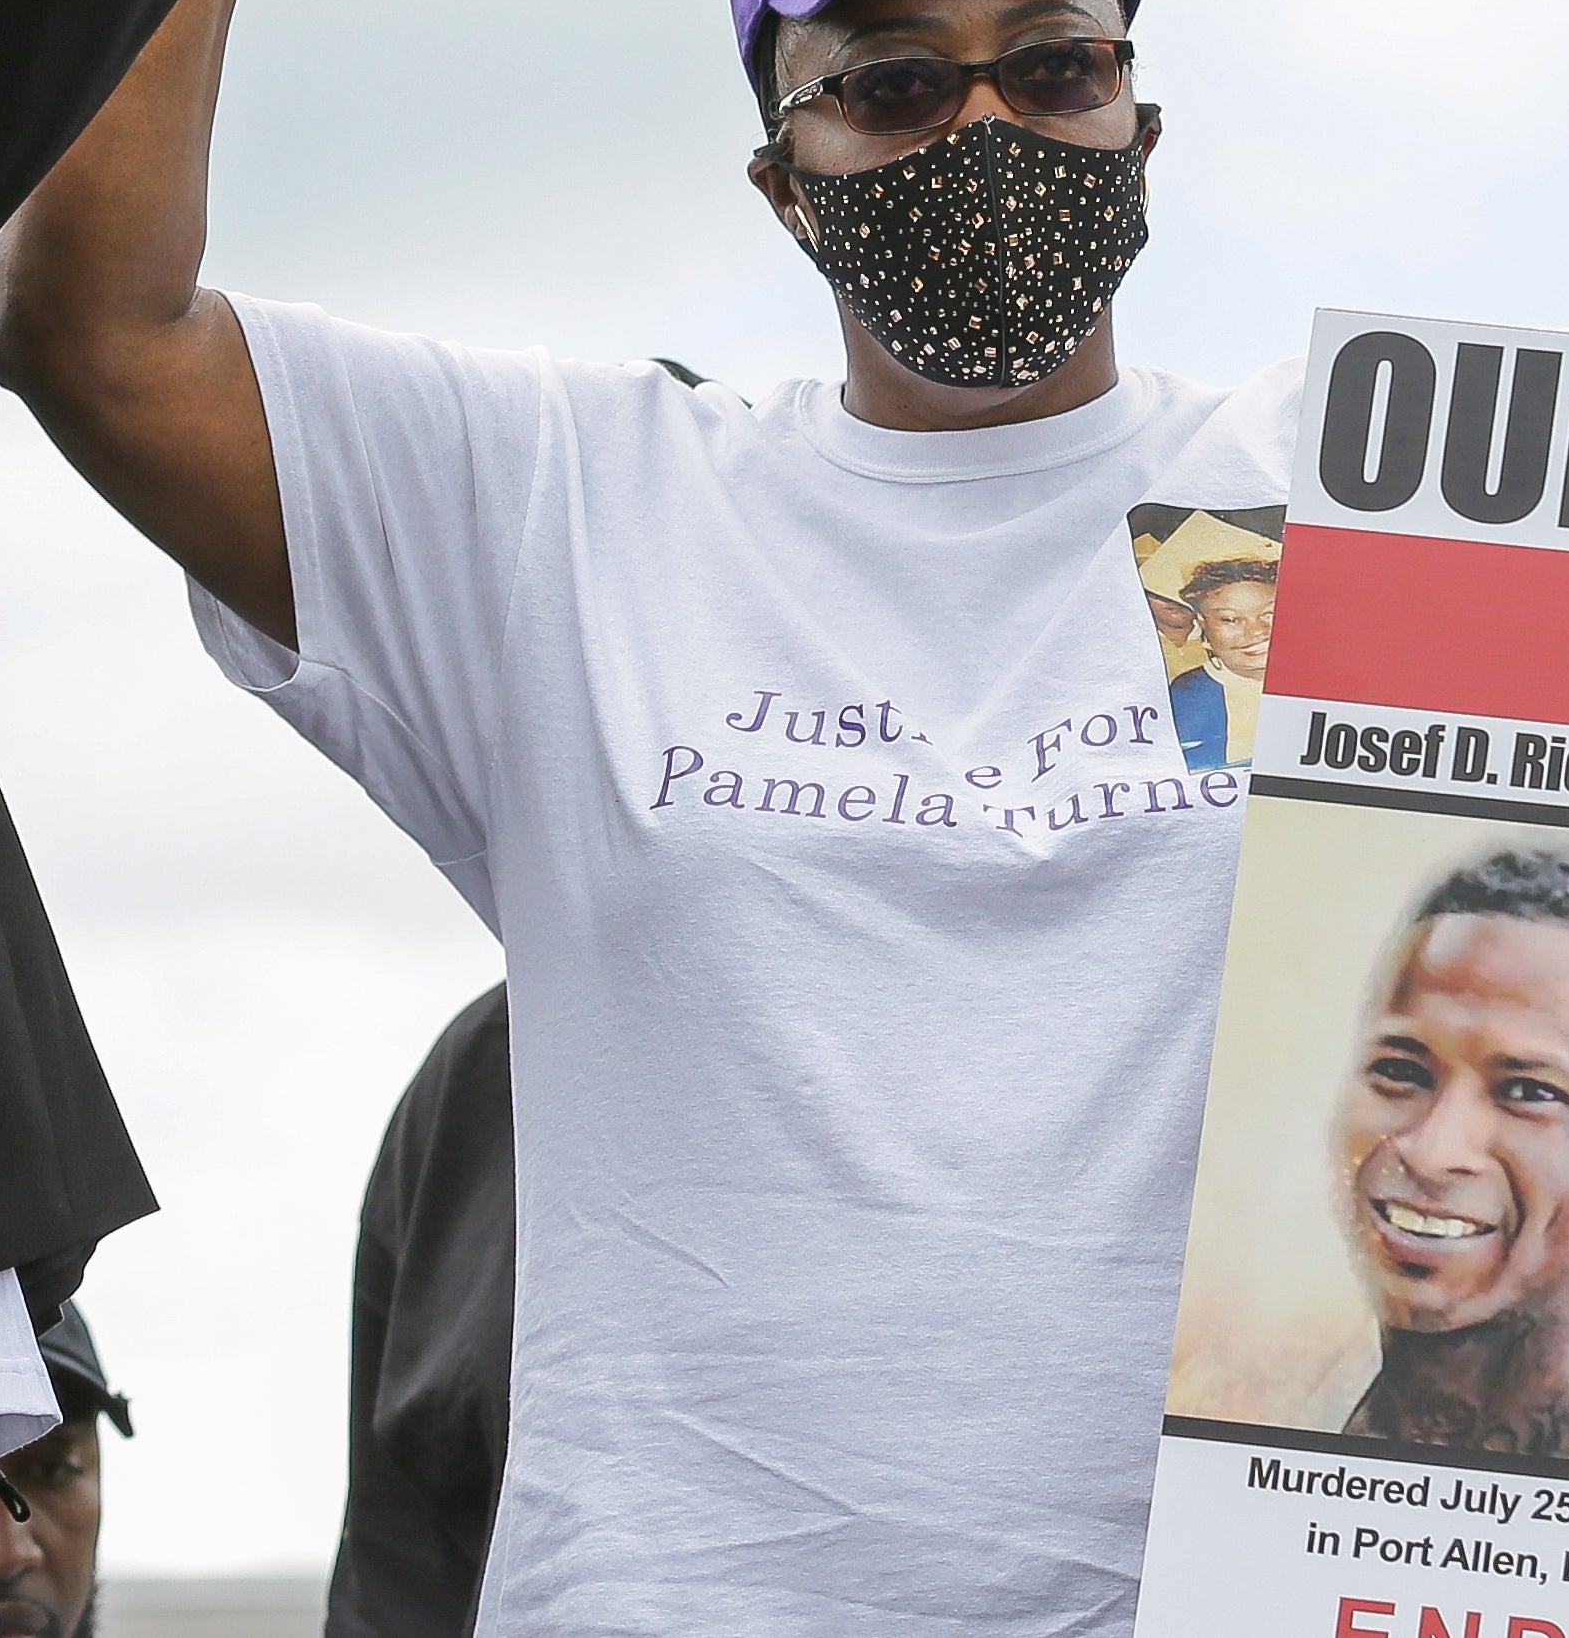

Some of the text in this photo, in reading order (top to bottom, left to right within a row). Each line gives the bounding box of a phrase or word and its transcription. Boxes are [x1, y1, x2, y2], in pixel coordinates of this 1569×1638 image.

[1026, 704, 1159, 784] For
[1299, 710, 1445, 779] Josef
[1449, 726, 1498, 784] D.
[649, 745, 1251, 838] Pamela Turne
[1247, 1456, 1431, 1509] Murdered
[1440, 1480, 1522, 1525] July
[1305, 1522, 1340, 1556] in
[1352, 1527, 1434, 1568] Port
[1440, 1538, 1548, 1585] Allen,
